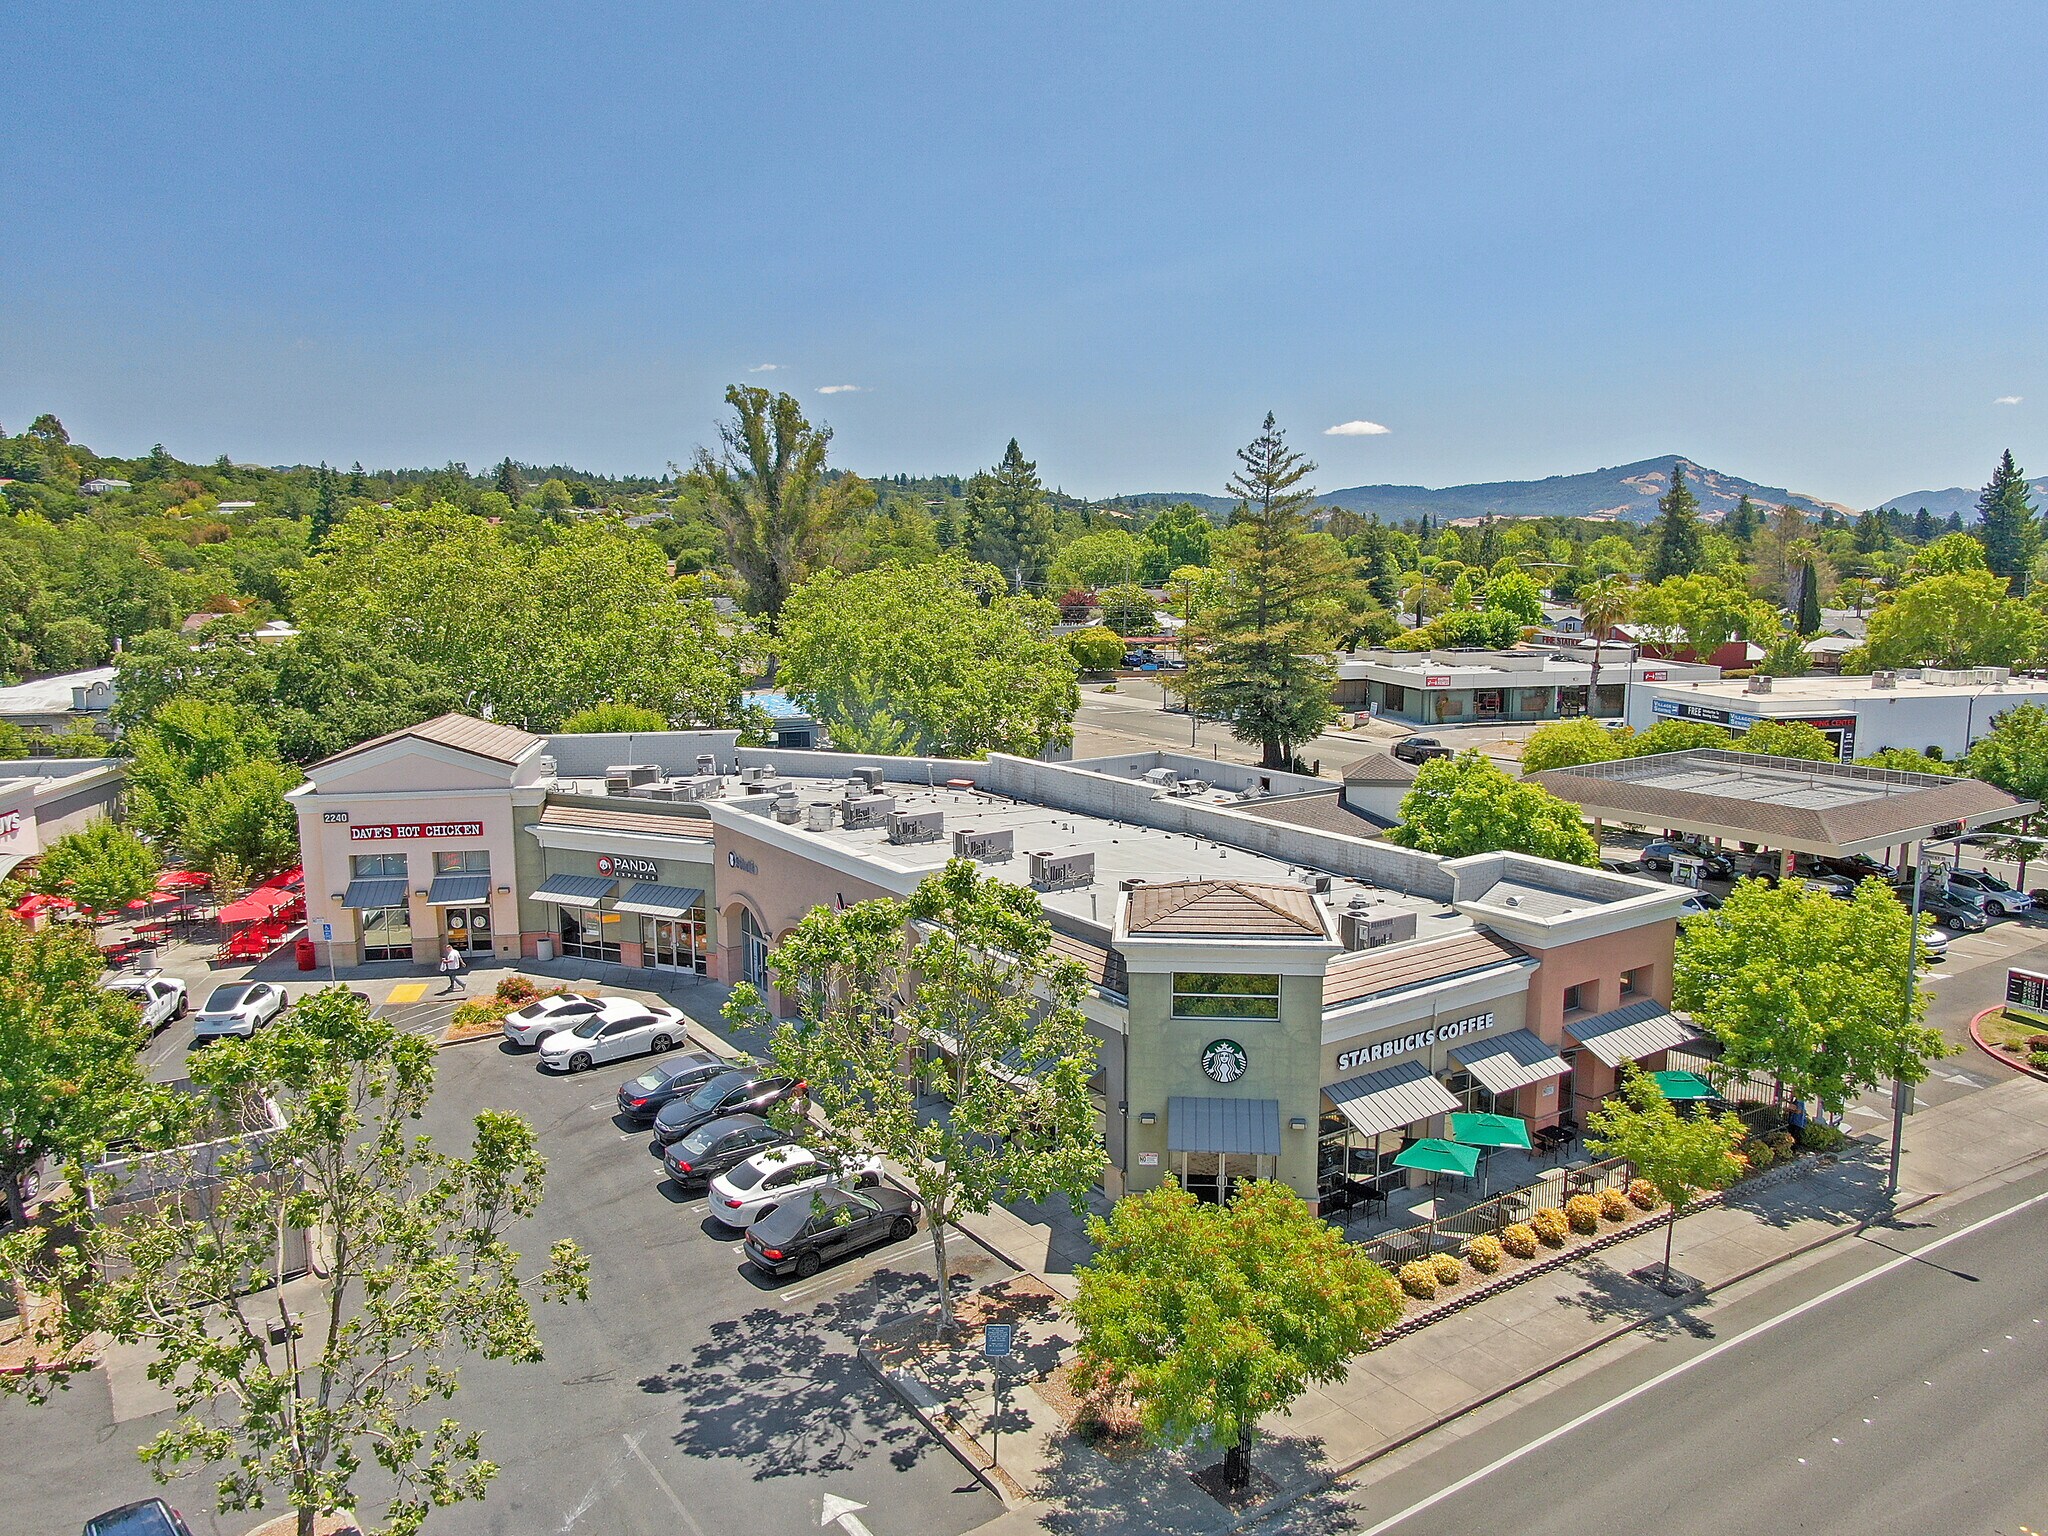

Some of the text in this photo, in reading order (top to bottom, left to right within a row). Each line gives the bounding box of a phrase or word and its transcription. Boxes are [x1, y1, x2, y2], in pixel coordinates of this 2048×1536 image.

[1688, 706, 1701, 717] FREE
[1831, 719, 1855, 727] CENTER
[324, 813, 347, 823] 2240
[351, 824, 480, 839] DAVE'S HOT CHICKEN
[613, 857, 657, 873] PANDA
[615, 871, 656, 881] EXPRESS
[1338, 1012, 1494, 1071] STARBUCKS COFFEE
